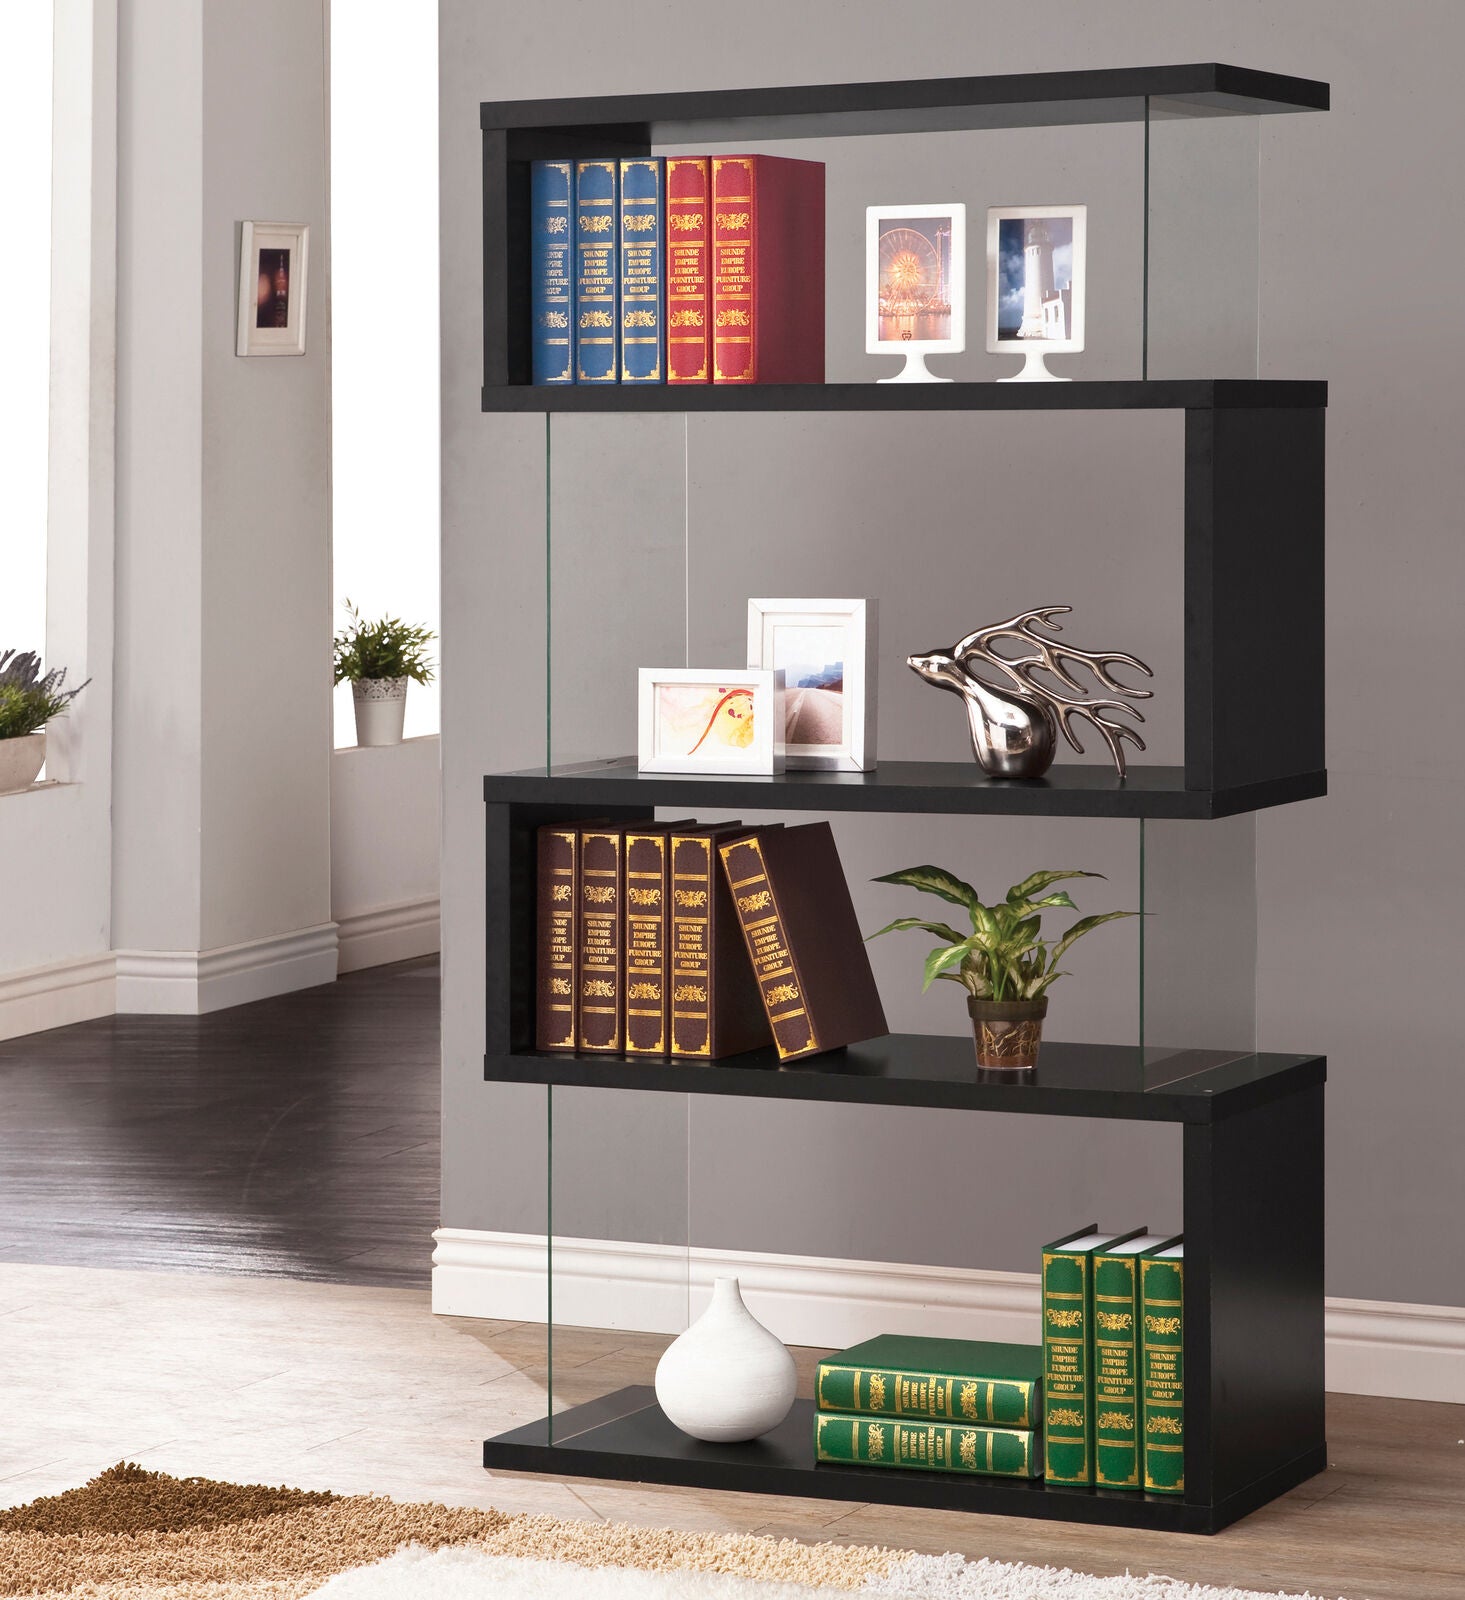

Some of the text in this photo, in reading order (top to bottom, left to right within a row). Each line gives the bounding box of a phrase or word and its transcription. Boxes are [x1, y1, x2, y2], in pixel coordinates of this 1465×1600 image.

[632, 922, 657, 930] SHUNDE
[678, 924, 703, 932] SHUNDE
[751, 924, 776, 938] SHUNDE
[634, 932, 656, 940] EMPIRE
[680, 934, 702, 942] EMPIRE
[754, 934, 778, 946] EMPIRE
[588, 938, 611, 946] EUROPE
[633, 940, 656, 948] EUROPE
[679, 942, 702, 950] EUROPE
[756, 942, 780, 955] EUROPE
[628, 950, 662, 958] FURNITURE
[674, 952, 708, 960] FURNITURE
[754, 949, 788, 966] FURNITURE
[588, 956, 609, 964] GROUP
[680, 960, 700, 968] GROUP
[1102, 1348, 1128, 1356] SHUNDE
[1150, 1352, 1176, 1360] SHUNDE
[1102, 1358, 1128, 1366] EMPIRE
[1150, 1362, 1176, 1370] EMPIRE
[1052, 1364, 1078, 1372] EUROPE
[1102, 1367, 1128, 1376] EUROPE
[1048, 1373, 1084, 1381] FURNITURE
[1098, 1376, 1134, 1384] FURNITURE
[1150, 1372, 1176, 1380] EUROPE
[1054, 1383, 1076, 1391] GROUP
[1146, 1380, 1182, 1389] FURNITURE
[1104, 1386, 1126, 1394] GROUP
[1152, 1390, 1174, 1398] GROUP
